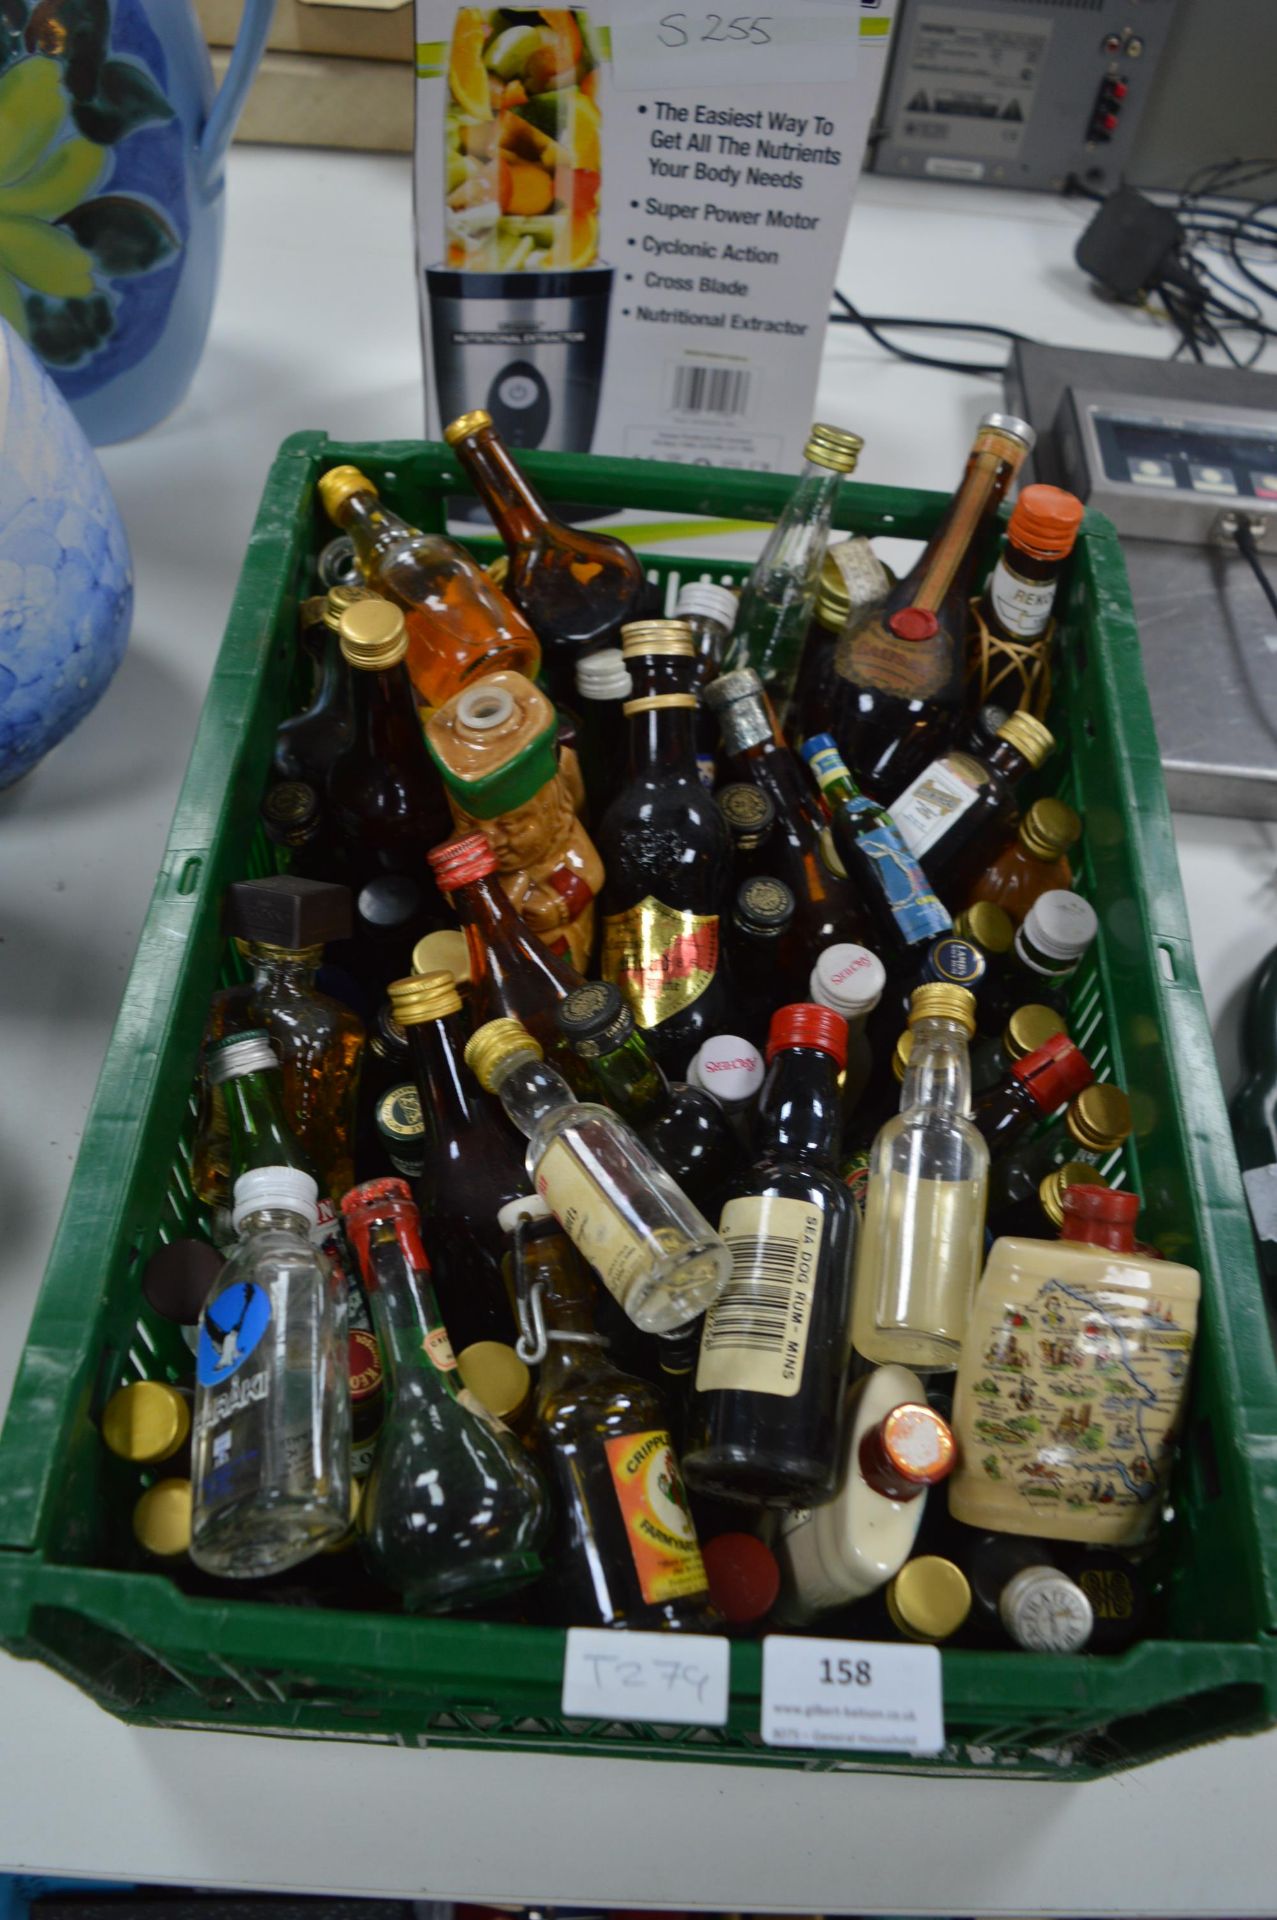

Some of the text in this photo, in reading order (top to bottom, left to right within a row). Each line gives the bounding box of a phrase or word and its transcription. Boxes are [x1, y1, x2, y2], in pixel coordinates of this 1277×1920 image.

[654, 101, 835, 137] The Easiest Way To
[650, 130, 842, 165] Get All The Nutrients
[648, 157, 804, 190] Your Body Needs
[645, 198, 820, 230] Super Power Motor
[642, 235, 779, 264] Cyclonic Action
[644, 271, 749, 296] Cross Blade
[635, 306, 809, 335] Nutritional Extractor
[802, 1216, 818, 1245] SEA
[798, 1252, 813, 1285] DOG
[791, 1292, 807, 1324] RUM
[783, 1340, 799, 1381] MINS
[819, 1658, 872, 1685] 158
